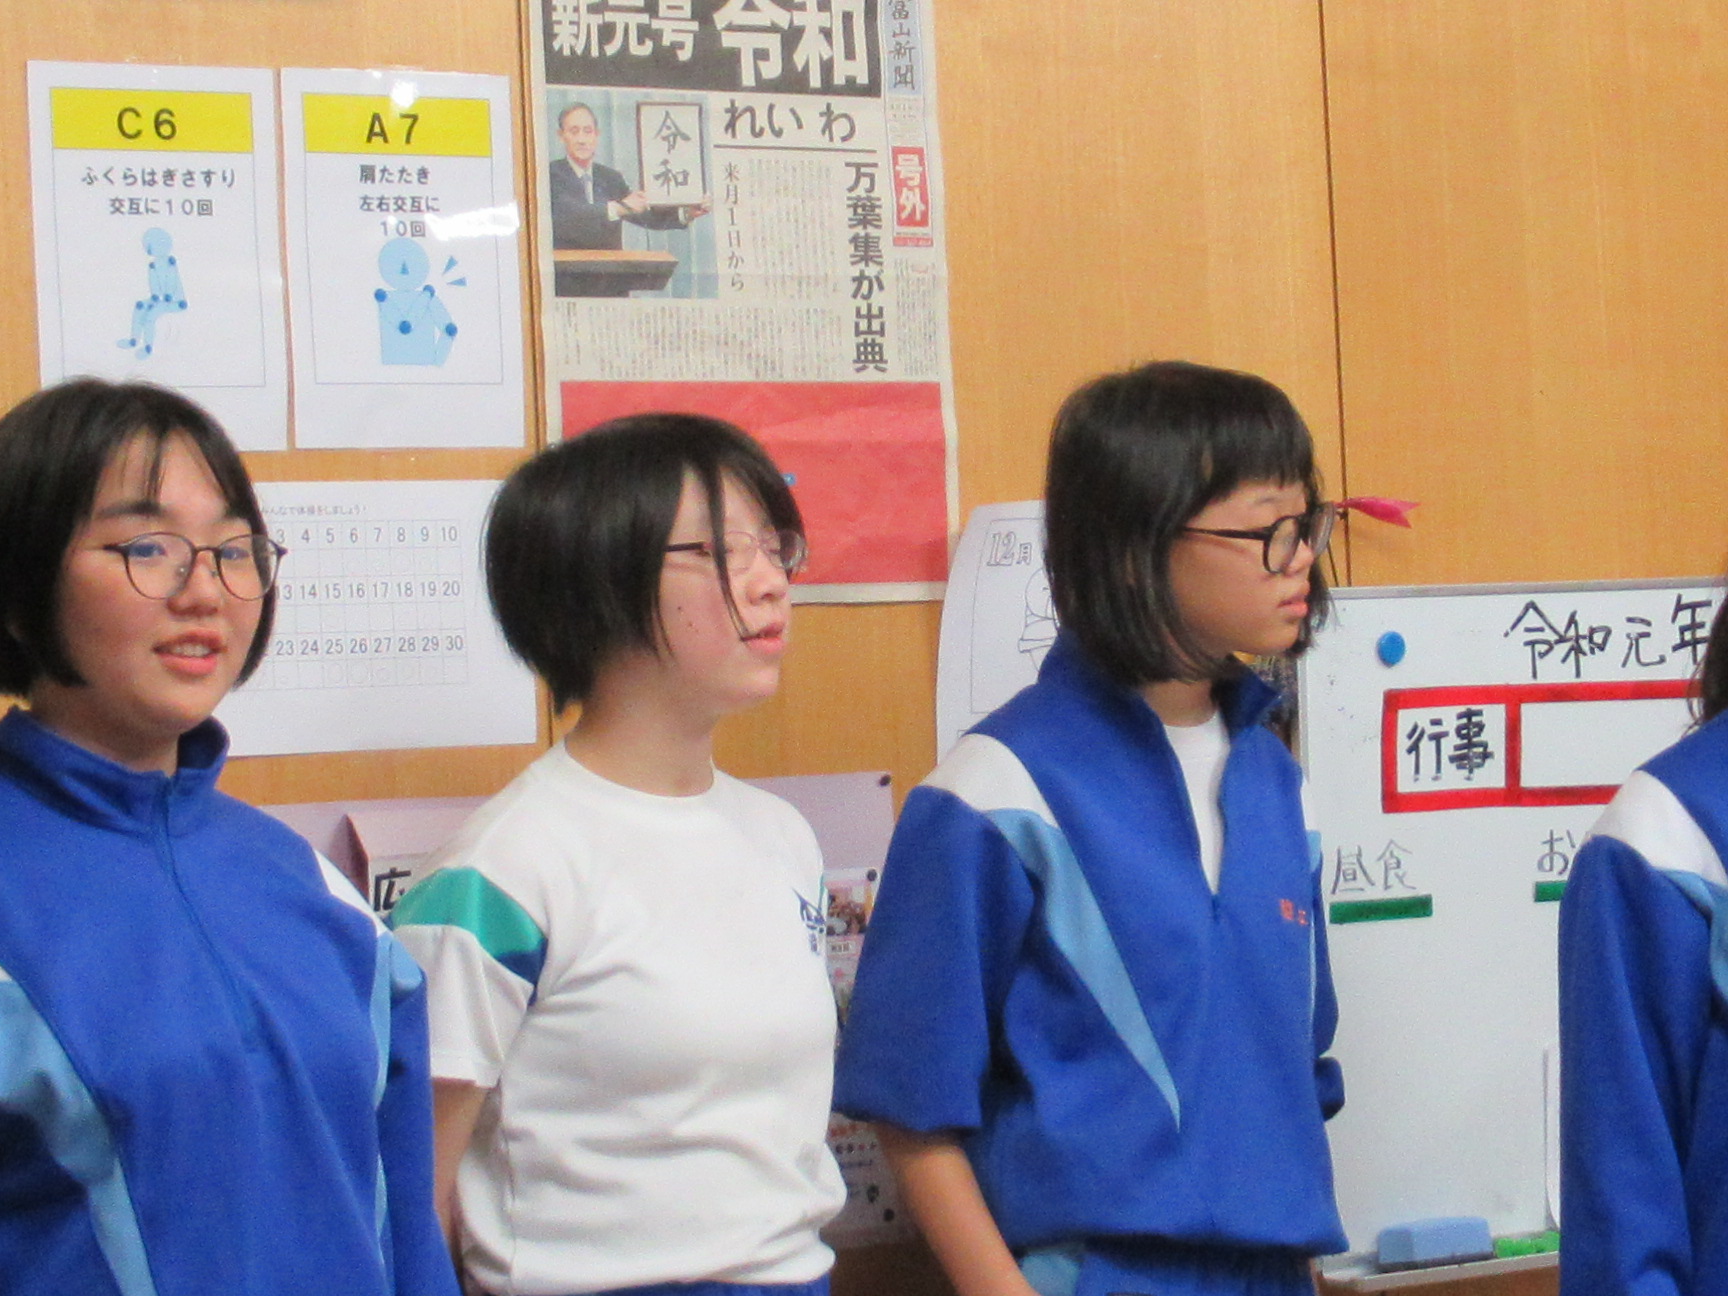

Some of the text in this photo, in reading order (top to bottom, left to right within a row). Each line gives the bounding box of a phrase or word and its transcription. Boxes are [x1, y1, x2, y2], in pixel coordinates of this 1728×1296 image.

[117, 107, 178, 140] C6
[366, 112, 420, 145] A7
[724, 99, 856, 143] れいわ
[654, 111, 691, 196] 令和
[81, 166, 237, 190] ふくらはぎさすり
[359, 164, 430, 185] 肩たたき
[895, 154, 926, 221] 号外
[109, 197, 214, 218] 交互に10回
[359, 195, 440, 214] 左右交互に
[380, 220, 426, 238] 10回
[844, 161, 889, 374] 万葉集が出典
[301, 528, 310, 544] 4
[326, 528, 335, 543] 5
[350, 528, 359, 543] 6
[374, 527, 382, 543] 7
[397, 527, 406, 543] 8
[421, 527, 429, 542] 9
[442, 526, 458, 542] 10
[986, 530, 1033, 567] 12月
[300, 584, 317, 600] 14
[325, 584, 341, 599] 15
[349, 583, 365, 599] 16
[373, 583, 389, 598] 17
[397, 582, 413, 598] 18
[421, 582, 437, 597] 19
[443, 581, 460, 596] 20
[276, 636, 464, 656] 23 24 25 26 27 28 29 30
[1503, 593, 1713, 679] 令和元年
[1406, 708, 1495, 781] 行事
[1331, 839, 1417, 894] 昼食
